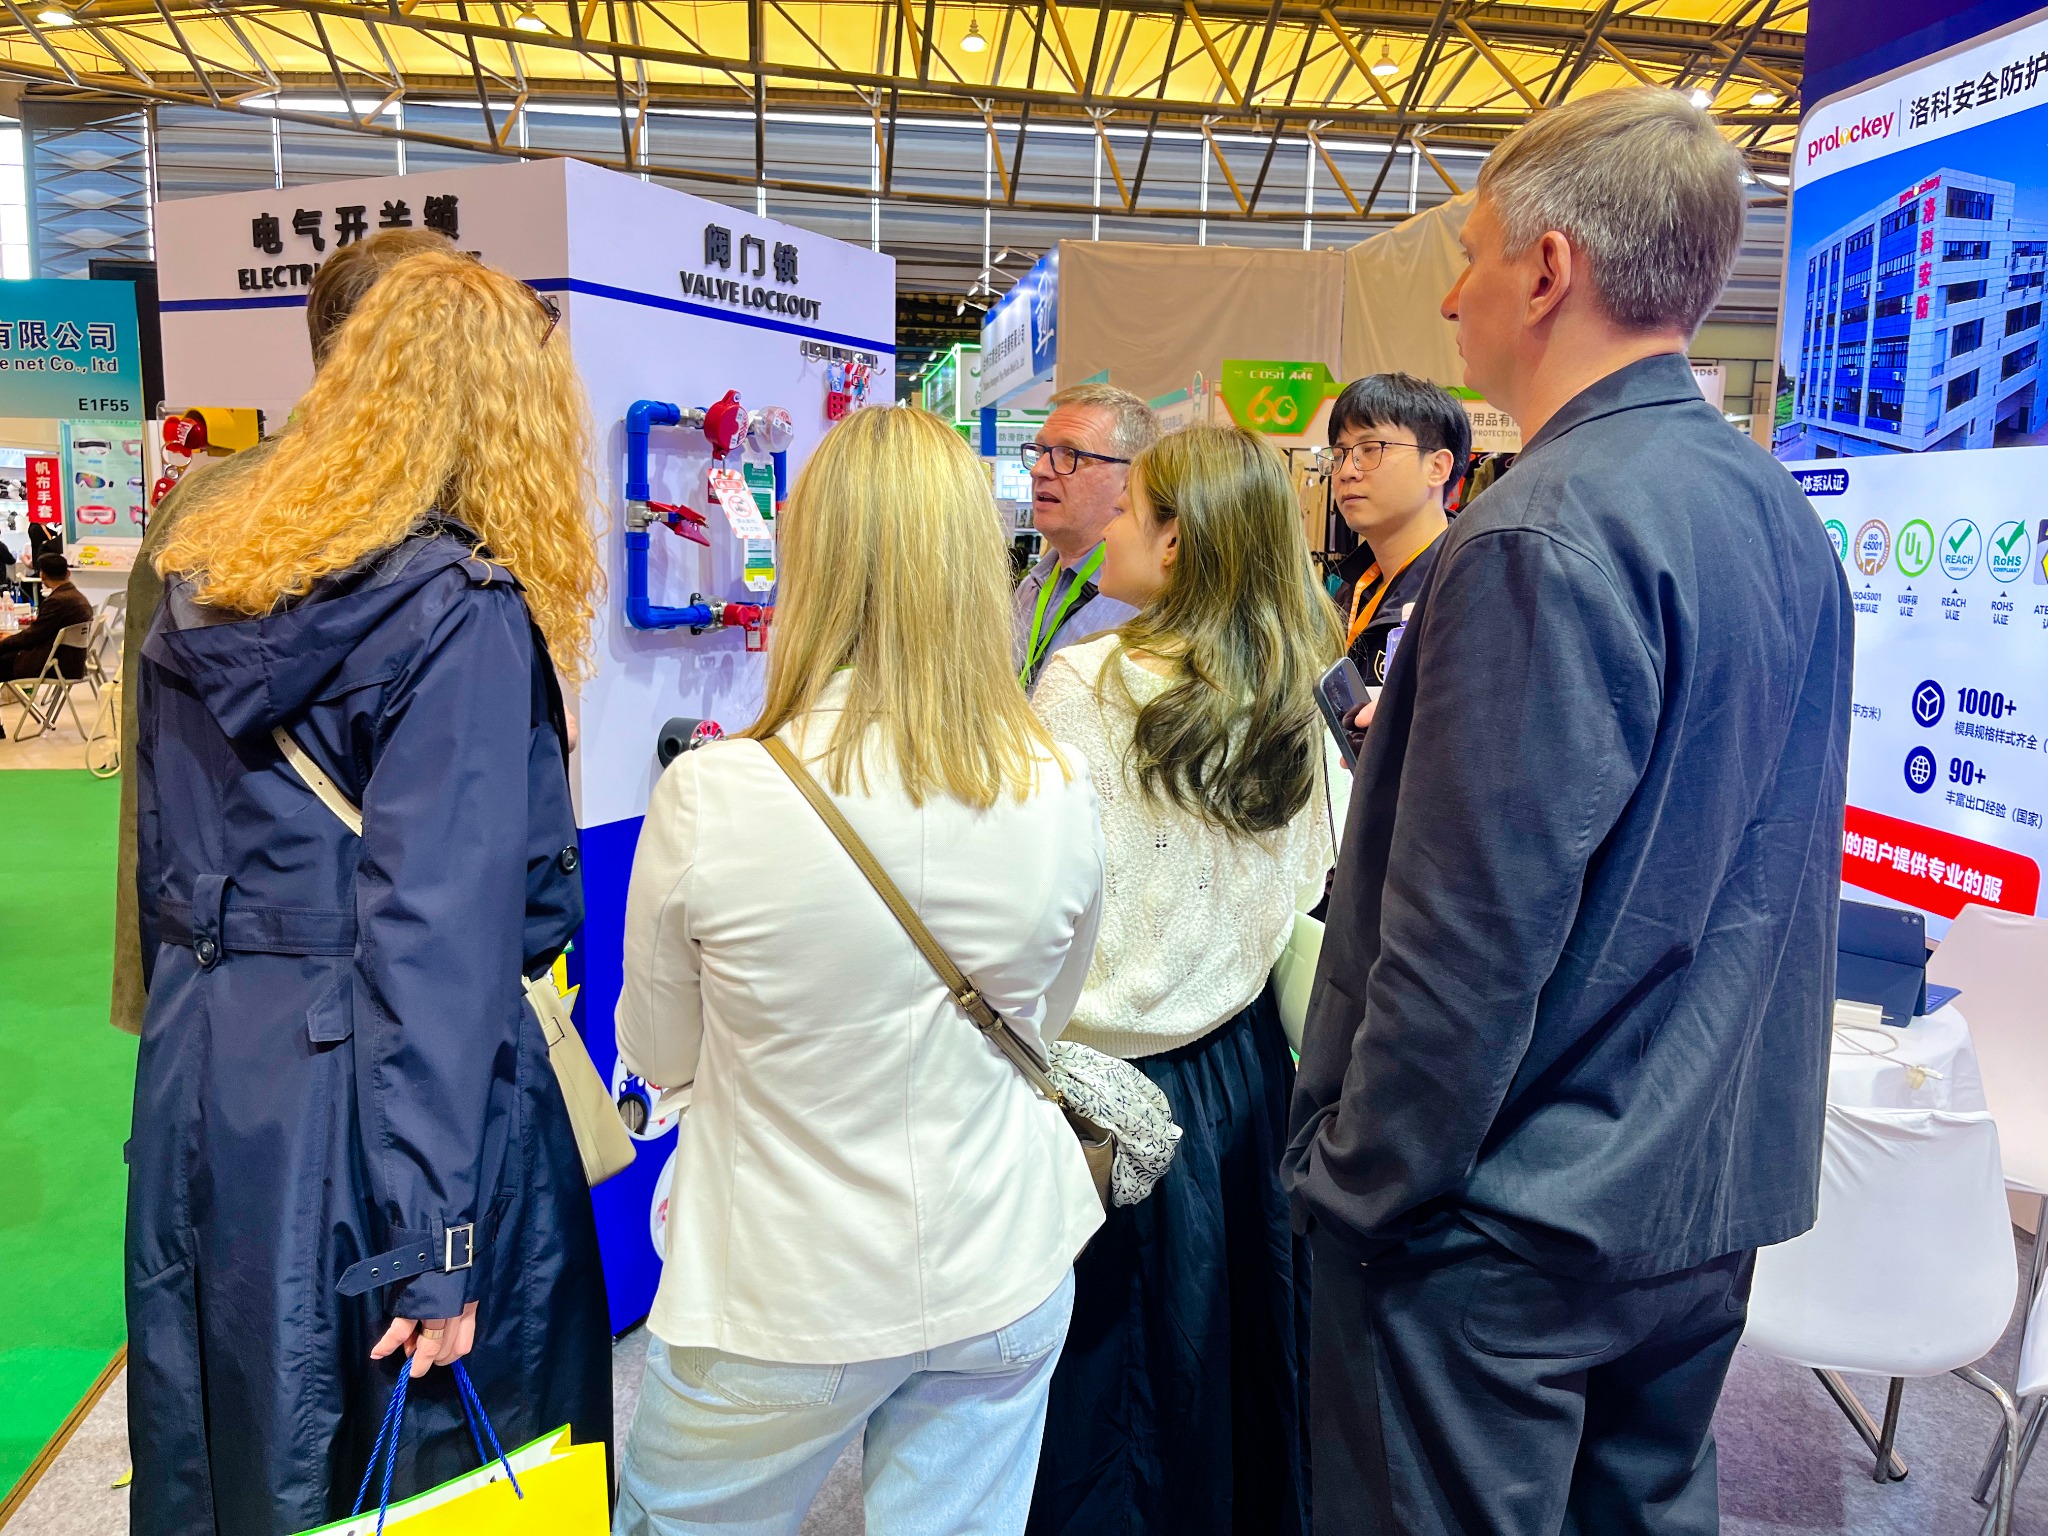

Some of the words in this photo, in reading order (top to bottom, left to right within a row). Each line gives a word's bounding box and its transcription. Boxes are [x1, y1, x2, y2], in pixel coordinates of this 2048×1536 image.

[1909, 50, 2048, 130] 洛科安全防护
[1808, 111, 1895, 166] prolockey
[705, 223, 799, 284] 阀门锁
[1916, 197, 1936, 320] 洛科安防
[680, 271, 739, 303] VALVE
[743, 285, 822, 320] LOCKOUT
[15, 358, 44, 371] net
[50, 356, 87, 374] Co.,
[78, 398, 130, 412] E1F55
[1466, 413, 1516, 427] 用品有
[1473, 429, 1519, 437] PROTECTION
[35, 460, 53, 519] 帆布手套
[1803, 474, 1845, 492] 体系认证
[1945, 554, 1974, 565] REACH
[1993, 555, 2022, 567] RoHS
[1900, 606, 1914, 617] 认证
[1941, 597, 1967, 608] REACH
[1991, 601, 2014, 612] ROHS
[1945, 609, 1961, 620] 认证
[1993, 613, 2010, 625] 认证
[1957, 687, 2017, 719] 1000+
[1949, 757, 1986, 786] 90+
[1843, 831, 2004, 904] 的用户提供专业的服
